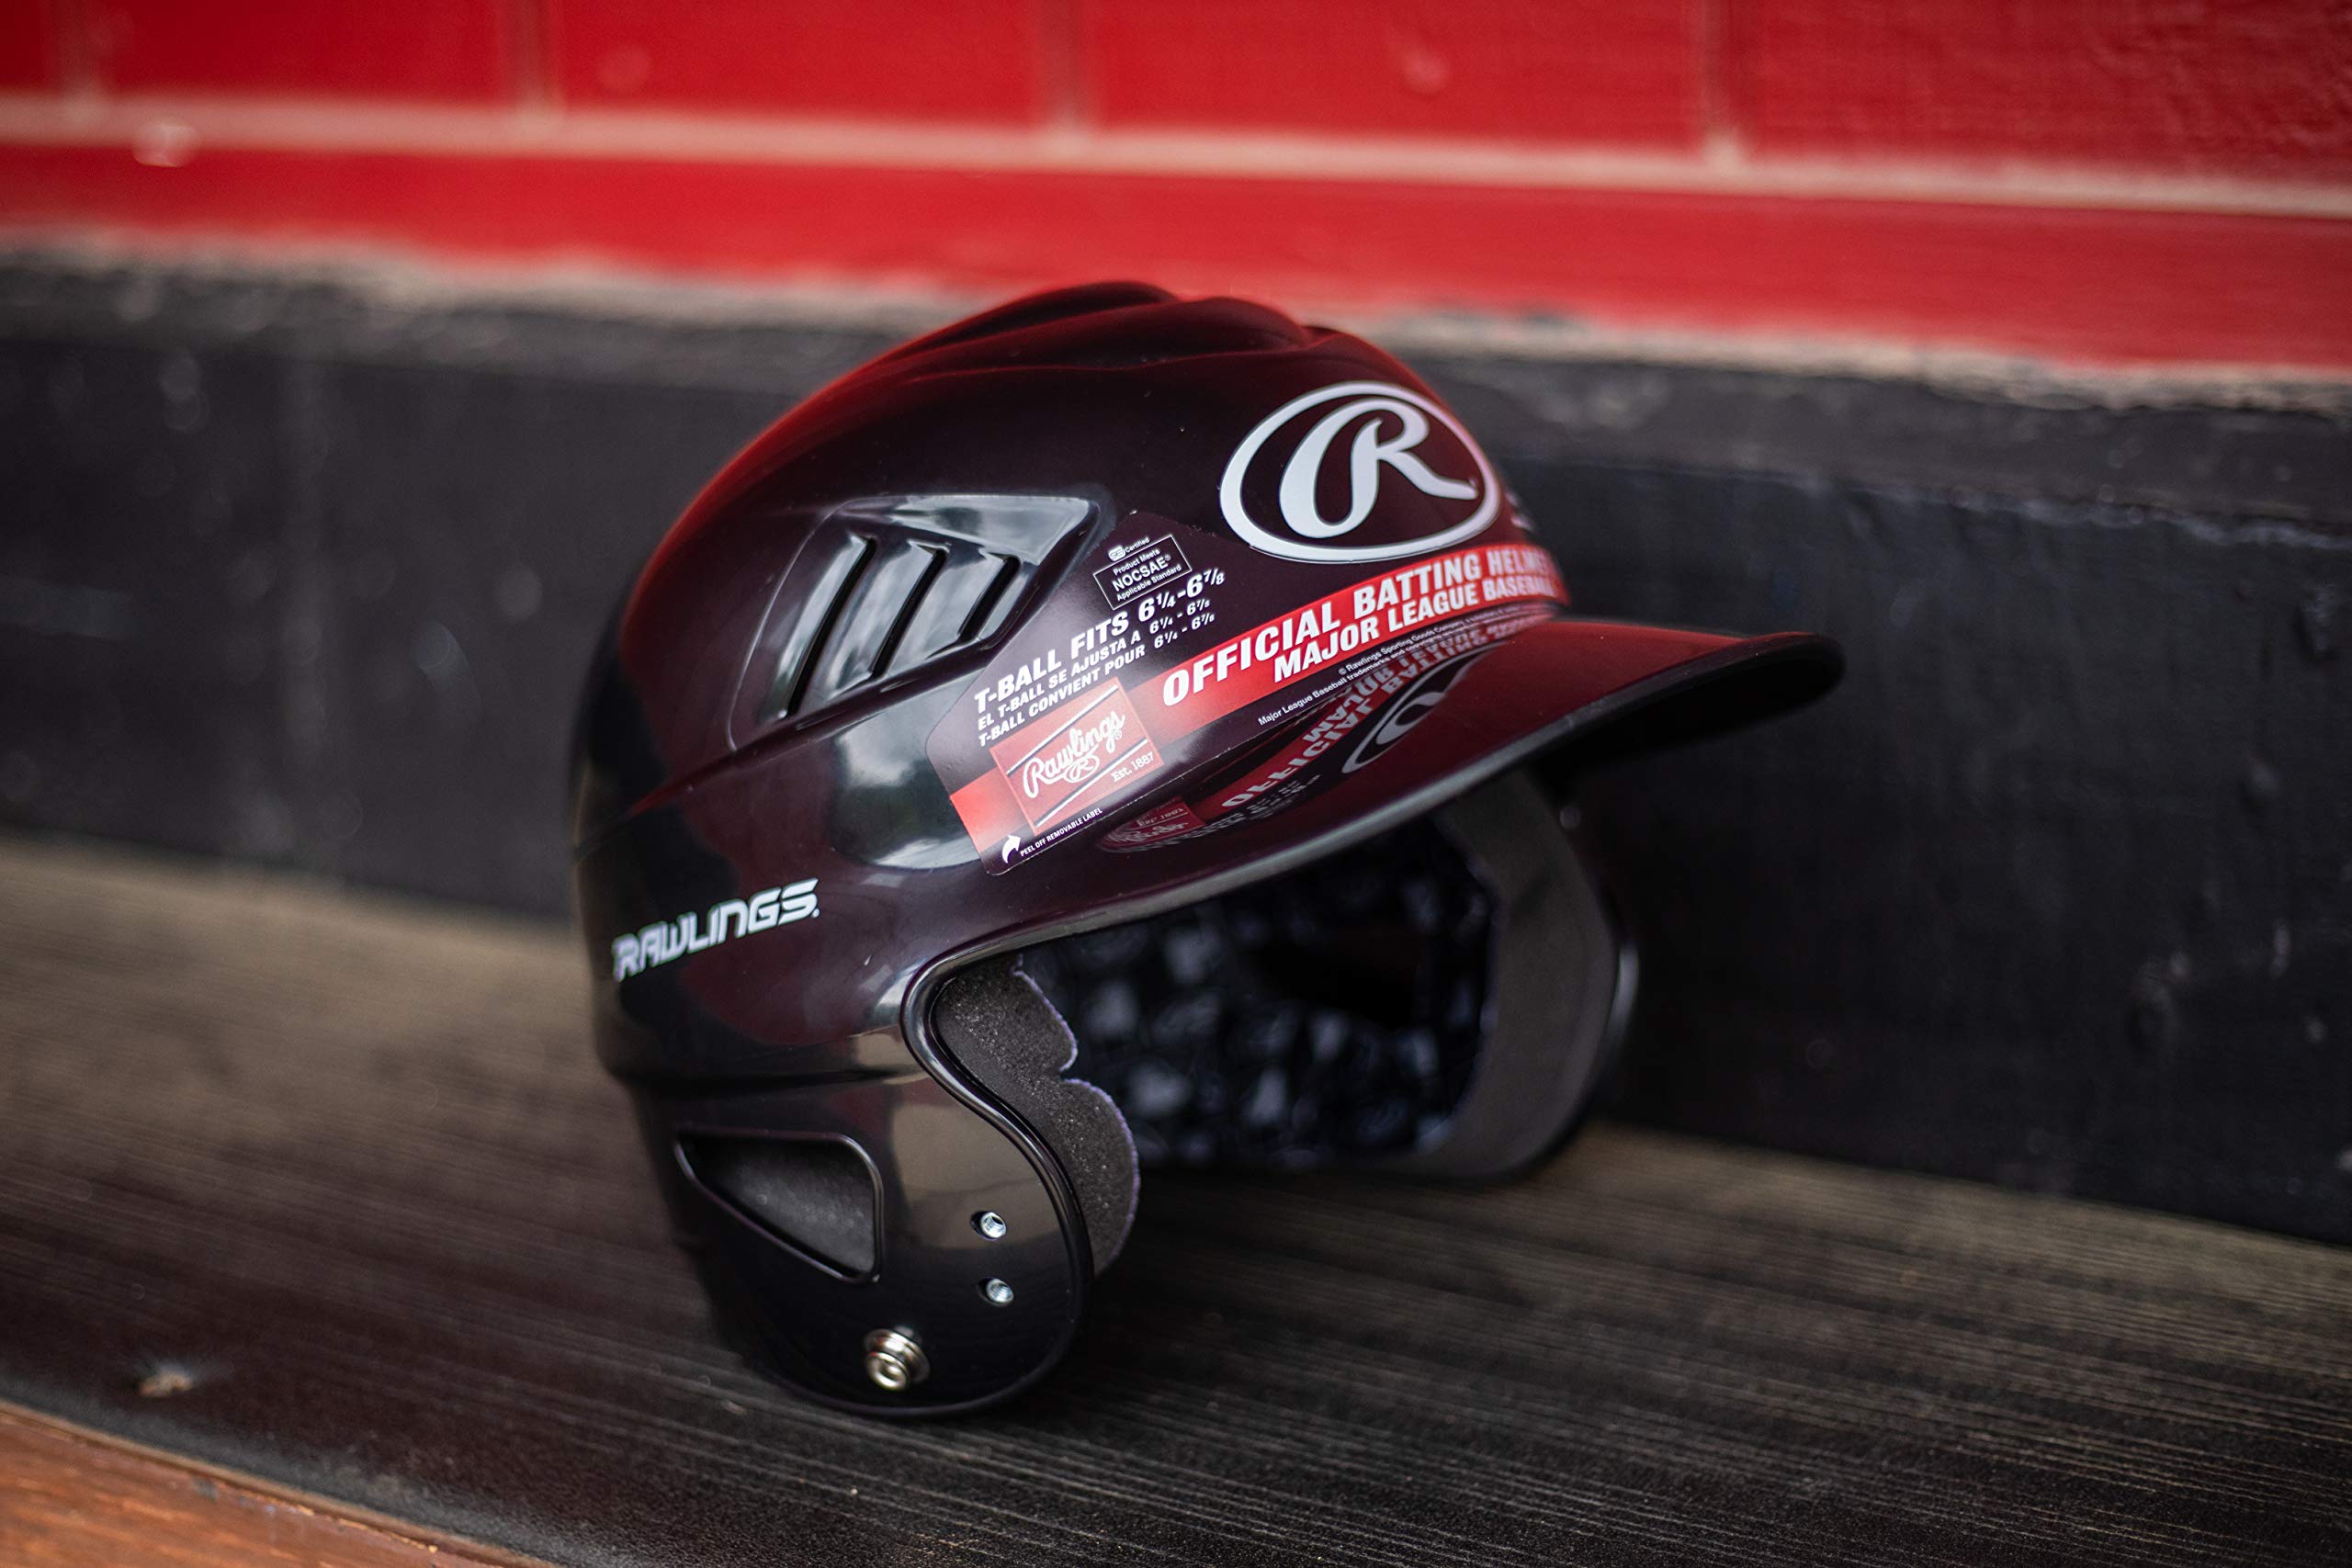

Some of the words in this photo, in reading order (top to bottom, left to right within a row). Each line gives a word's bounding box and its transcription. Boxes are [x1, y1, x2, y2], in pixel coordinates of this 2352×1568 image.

[1279, 397, 1478, 539] R
[1113, 558, 1140, 576] Product
[1140, 548, 1160, 562] Meets
[1116, 580, 1152, 602] Applicable
[1152, 564, 1182, 583] Standard
[1125, 537, 1150, 553] Certified
[974, 649, 1062, 714] T-BALL
[1070, 611, 1129, 660] FITS
[1163, 602, 1340, 707] OFFICIAL
[1353, 553, 1482, 620] BATTING
[1274, 616, 1379, 683] MAJOR
[1388, 581, 1479, 632] LEAGUE
[1346, 651, 1382, 671] Rawlings
[1381, 637, 1412, 656] Sporting
[978, 713, 994, 731] EL
[998, 683, 1045, 717] T-BALL
[1048, 669, 1068, 689] SE
[1070, 638, 1127, 676] AJUSTA
[1130, 630, 1141, 645] A
[978, 712, 1025, 747] T-BALL
[1029, 668, 1101, 716] CONVIENT
[1104, 645, 1146, 675] POUR
[1258, 706, 1283, 726] Major
[1282, 694, 1313, 713] League
[1312, 677, 1348, 698] Baseball
[1347, 657, 1390, 680] trademarks
[1390, 649, 1406, 660] and
[1112, 768, 1133, 783] Est.
[1131, 752, 1155, 771] 1887
[1020, 842, 1035, 856] PEEL
[1035, 837, 1047, 848] OFF
[1046, 818, 1084, 842] REMOVABLE
[1083, 807, 1103, 822] LABEL
[611, 876, 820, 983] RAWLINGS
